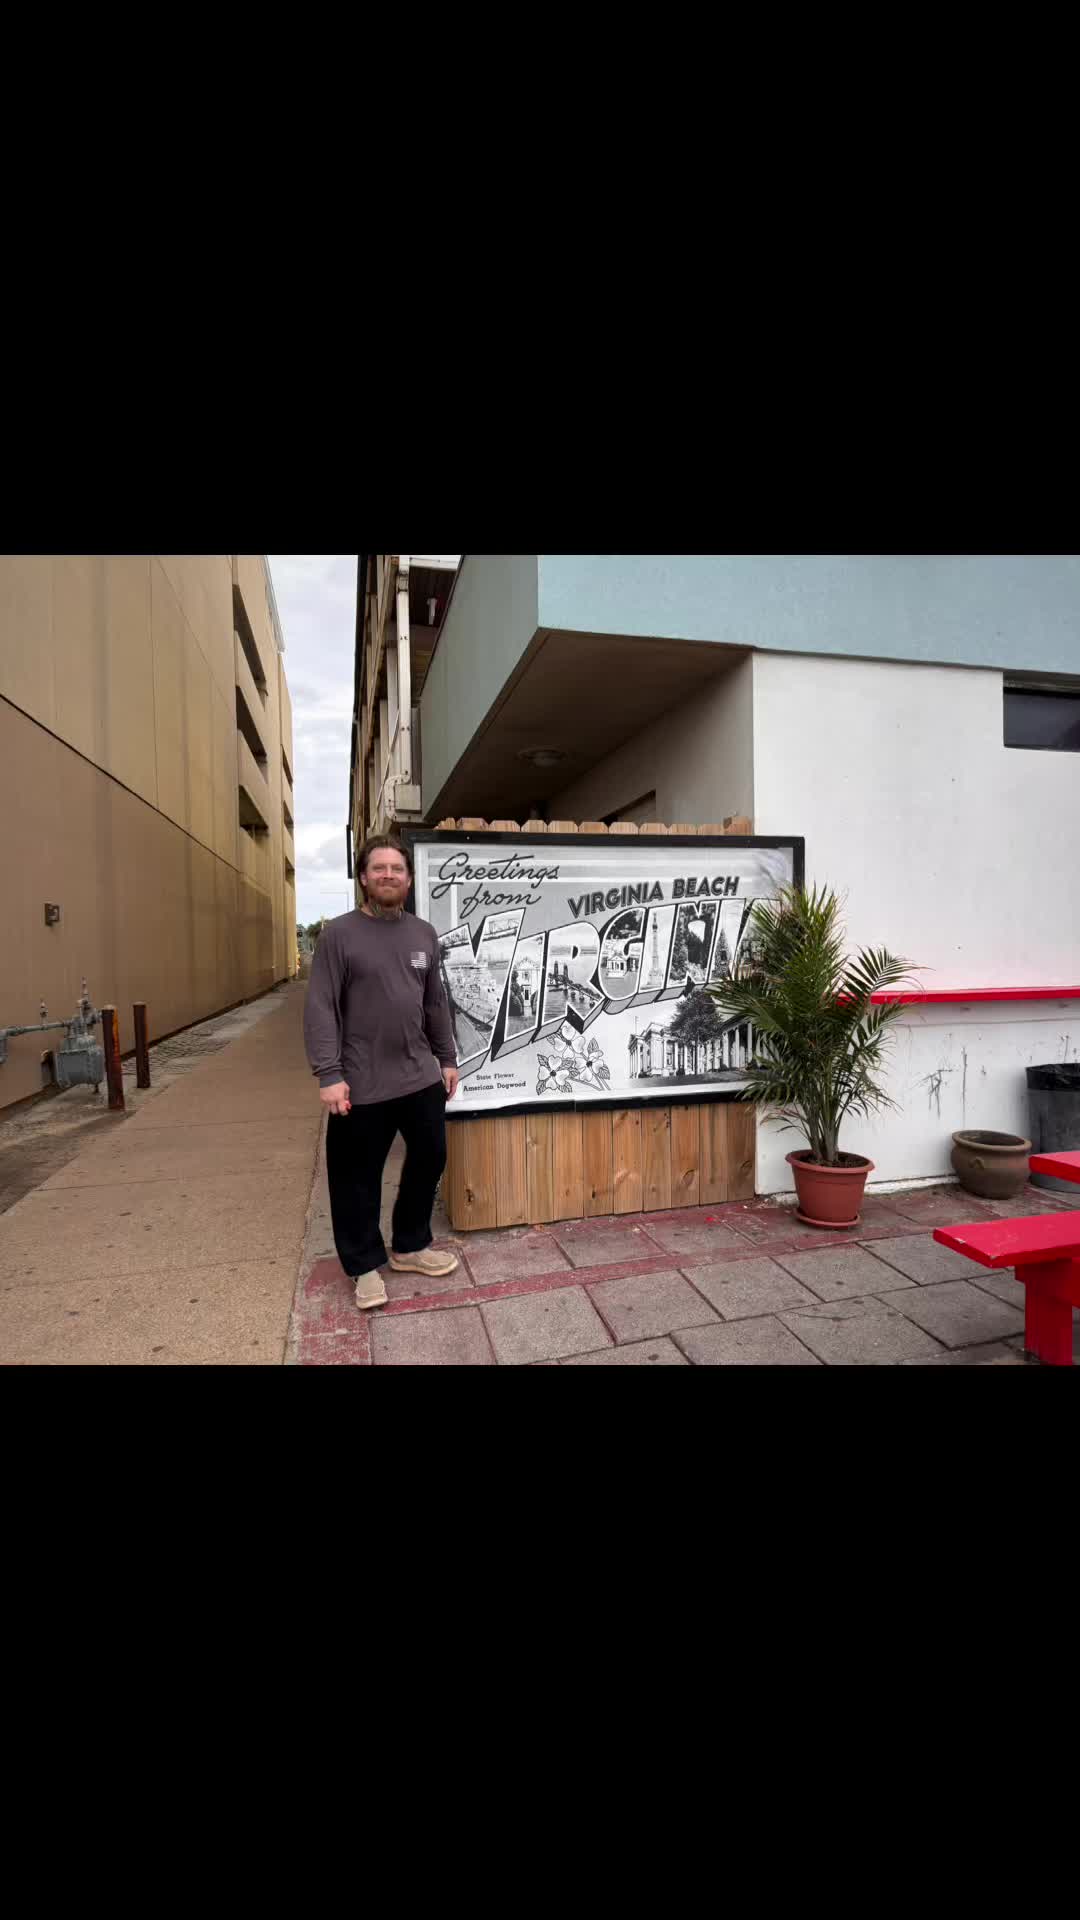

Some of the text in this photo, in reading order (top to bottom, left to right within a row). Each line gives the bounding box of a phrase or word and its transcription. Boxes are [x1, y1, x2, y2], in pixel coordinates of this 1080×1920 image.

[431, 852, 560, 899] Greetings
[460, 883, 543, 918] from
[567, 876, 739, 918] VIRGINIA BEACH
[497, 1081, 526, 1089] Dogwood
